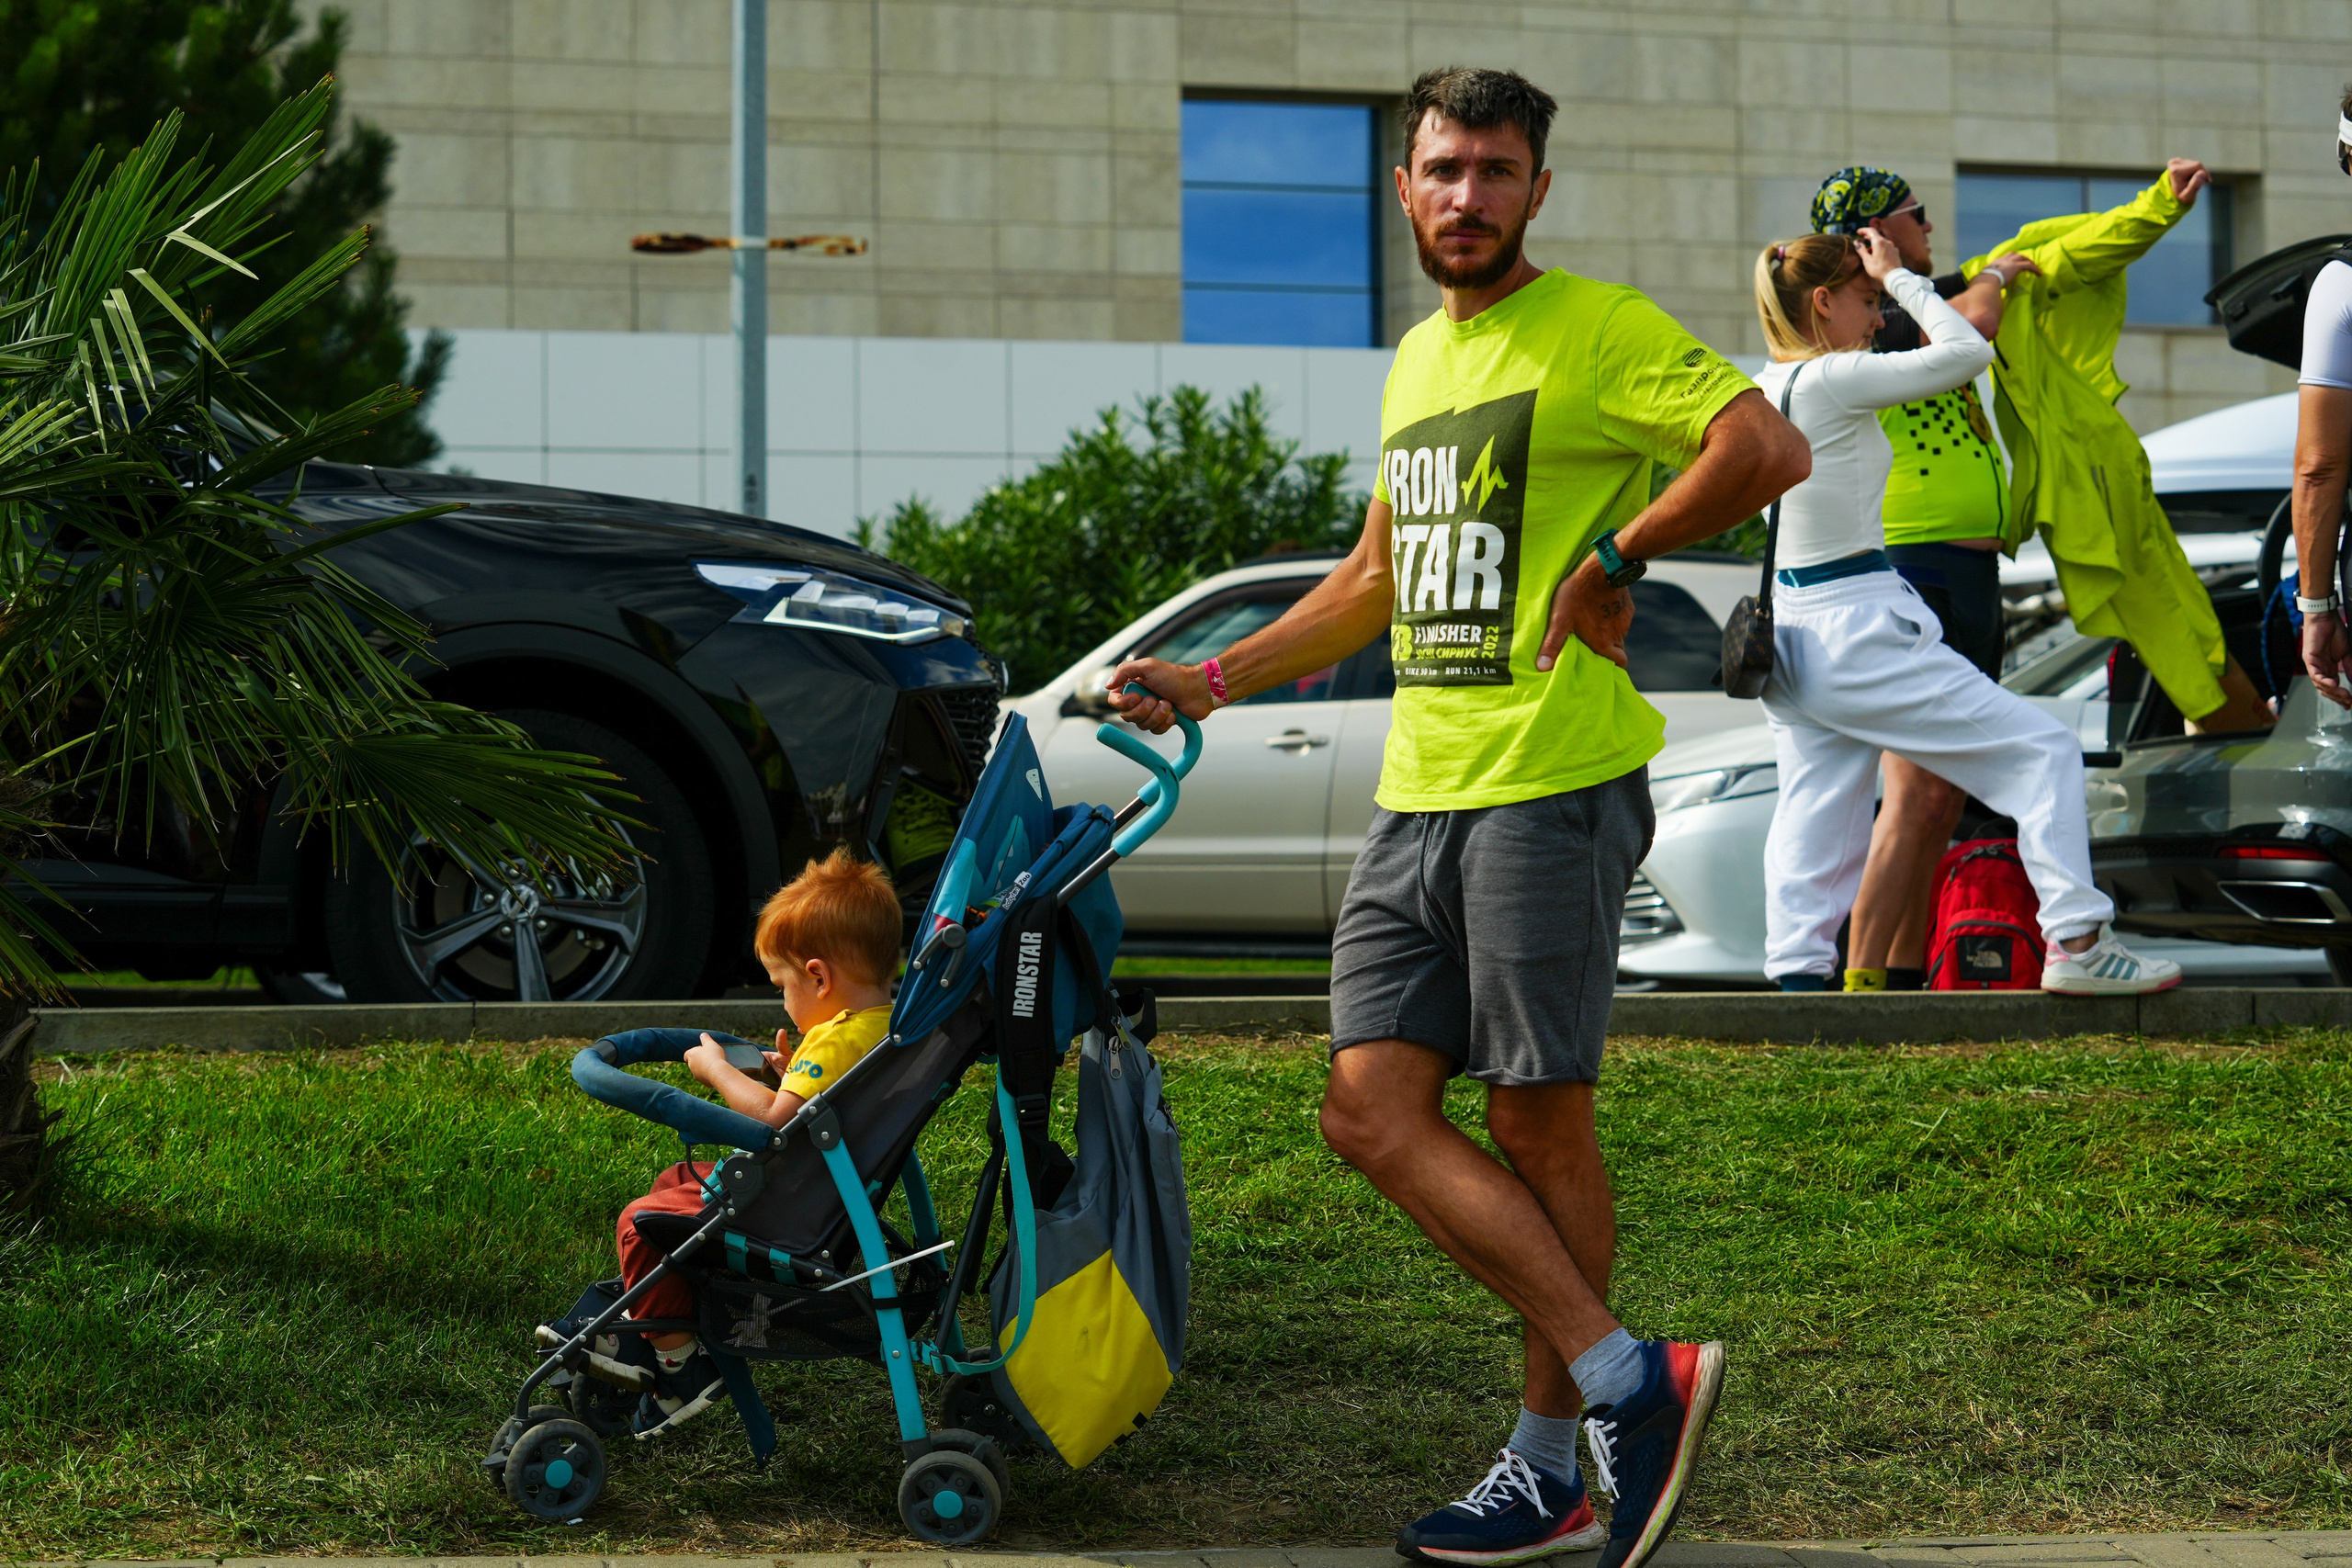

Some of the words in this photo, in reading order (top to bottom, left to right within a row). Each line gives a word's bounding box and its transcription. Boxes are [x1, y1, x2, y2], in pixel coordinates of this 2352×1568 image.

[1384, 446, 1458, 516] IRON
[1414, 624, 1482, 644] FINISHER
[1481, 626, 1499, 659] 2022
[1436, 647, 1478, 659] СИРИУС
[1405, 667, 1419, 676] BIKE
[1445, 667, 1461, 675] RUN
[1464, 666, 1480, 676] 21,1
[1012, 931, 1043, 1019] IRONSTAR
